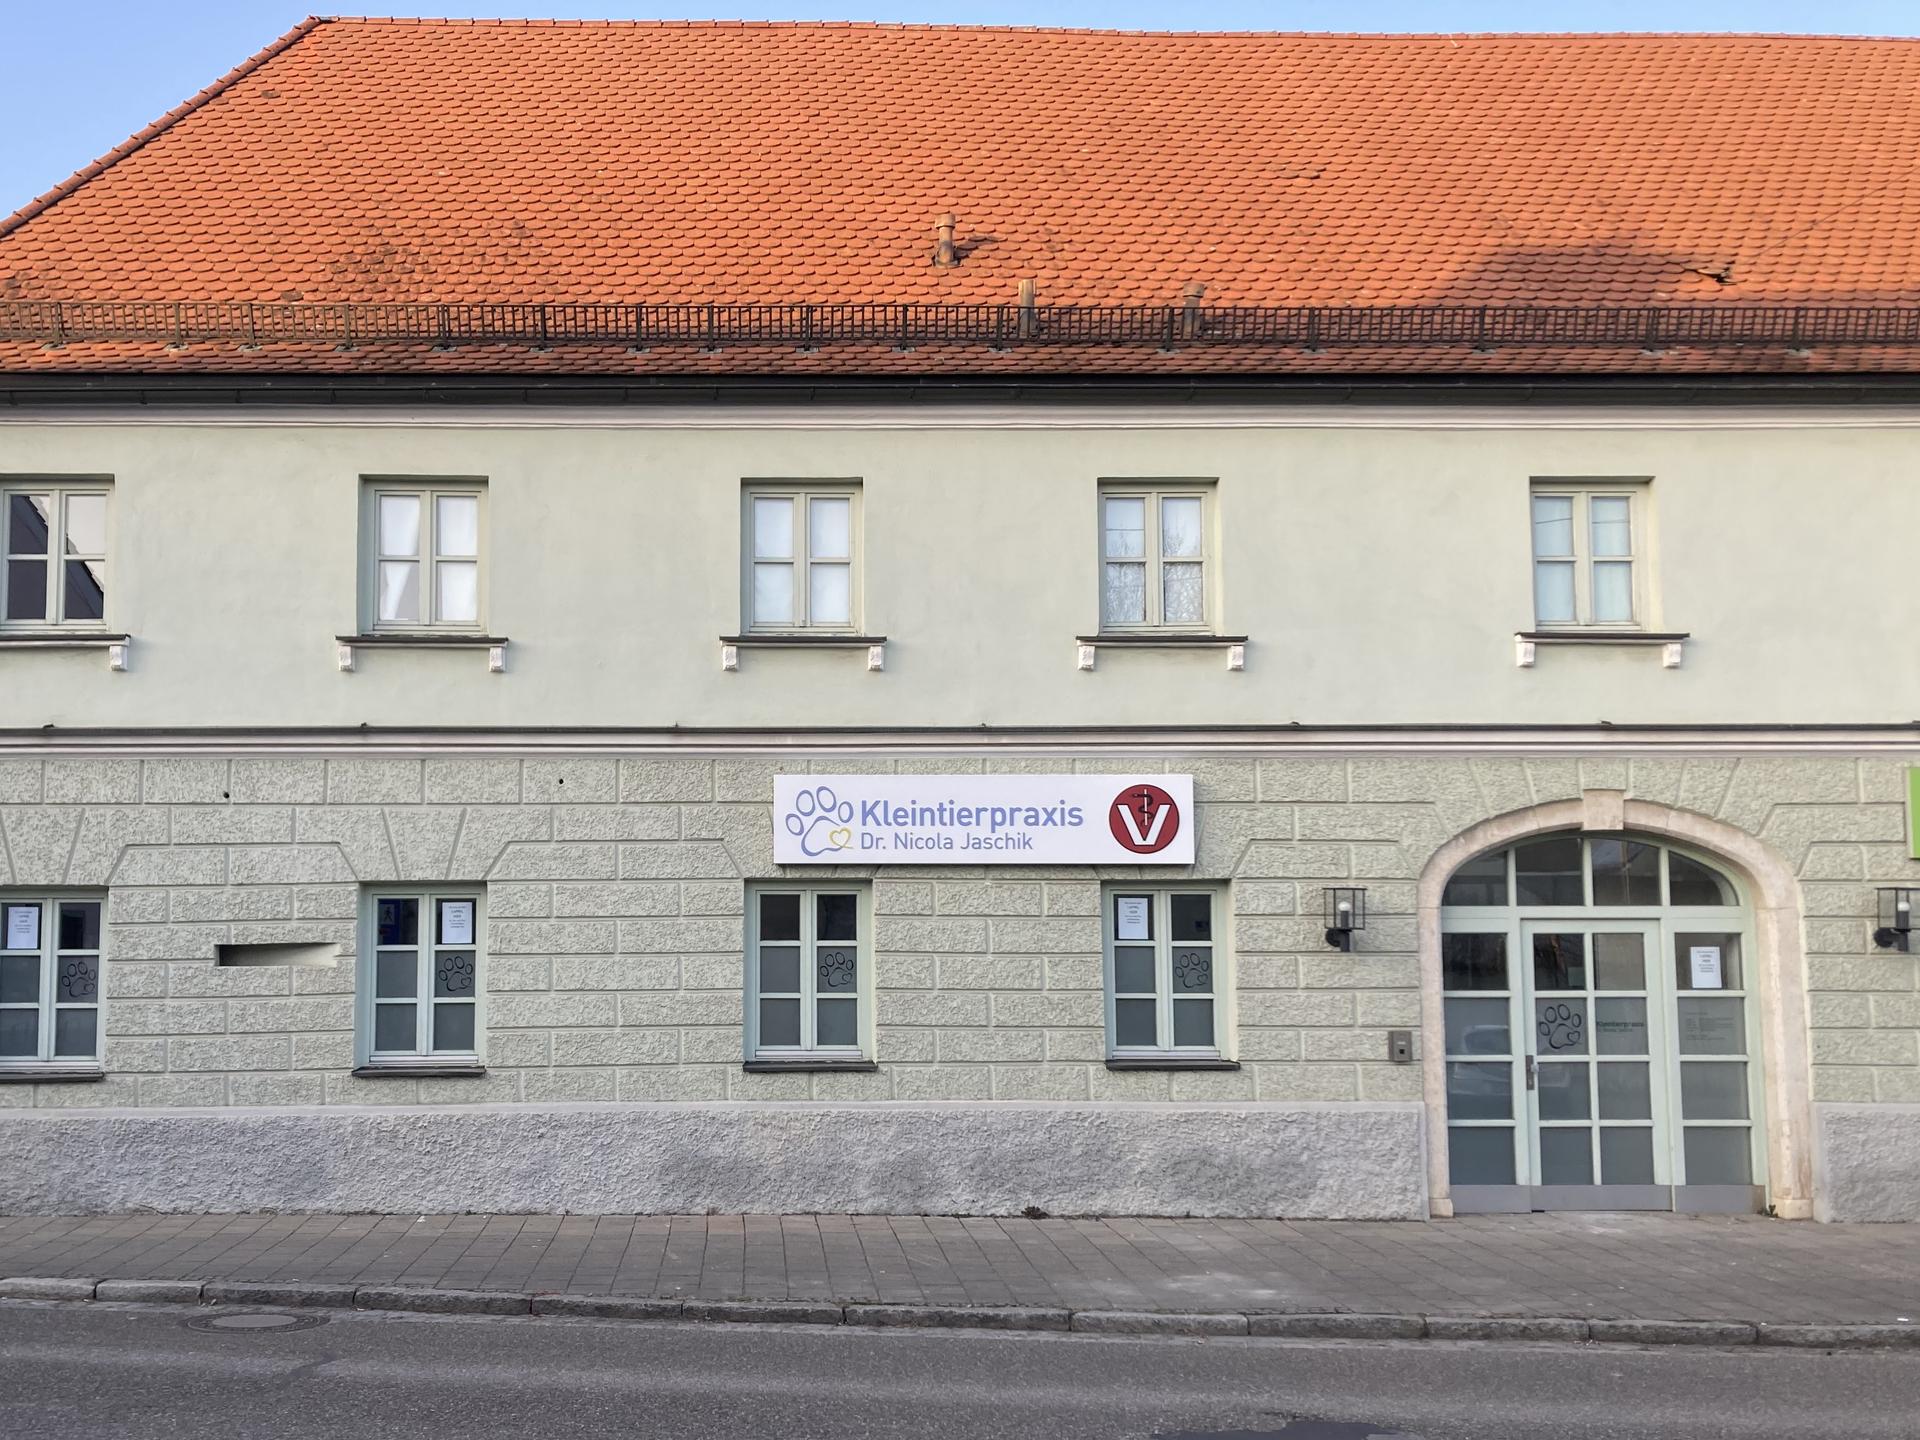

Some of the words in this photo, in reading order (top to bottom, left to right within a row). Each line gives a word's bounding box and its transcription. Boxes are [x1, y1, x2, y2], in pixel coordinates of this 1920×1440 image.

[861, 799, 1084, 833] Kleintierpraxis
[861, 832, 887, 850] Dr.
[894, 832, 954, 850] Nicola
[960, 832, 1033, 850] Jaschik
